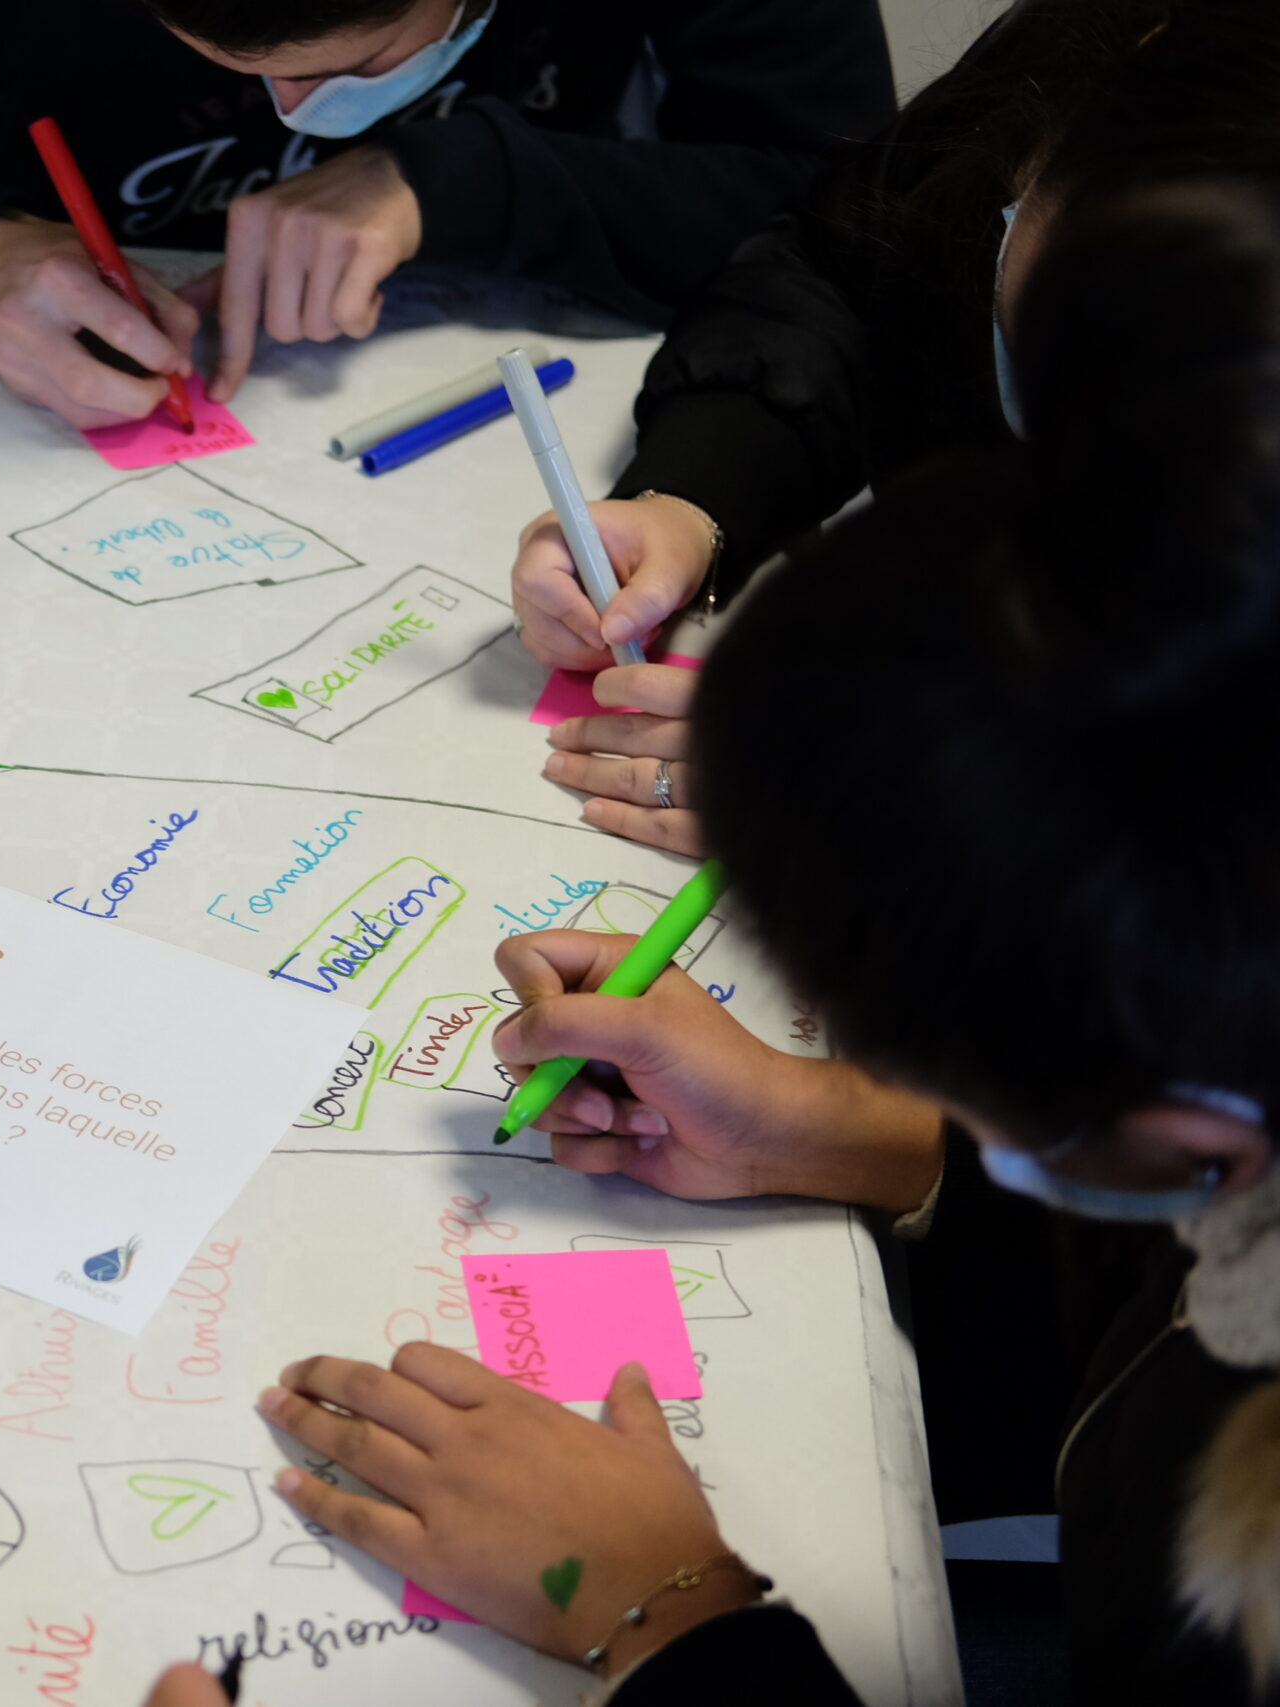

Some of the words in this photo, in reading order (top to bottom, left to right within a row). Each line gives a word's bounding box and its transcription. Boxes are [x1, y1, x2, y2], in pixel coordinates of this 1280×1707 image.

[170, 530, 306, 567] Statue
[206, 808, 363, 932] Formation
[269, 874, 450, 994] Tradition
[388, 1004, 489, 1079] Tinder
[49, 1062, 163, 1118] forces
[3, 1124, 28, 1145] ?
[34, 1095, 177, 1162] laquelle
[125, 1236, 242, 1405] Famille
